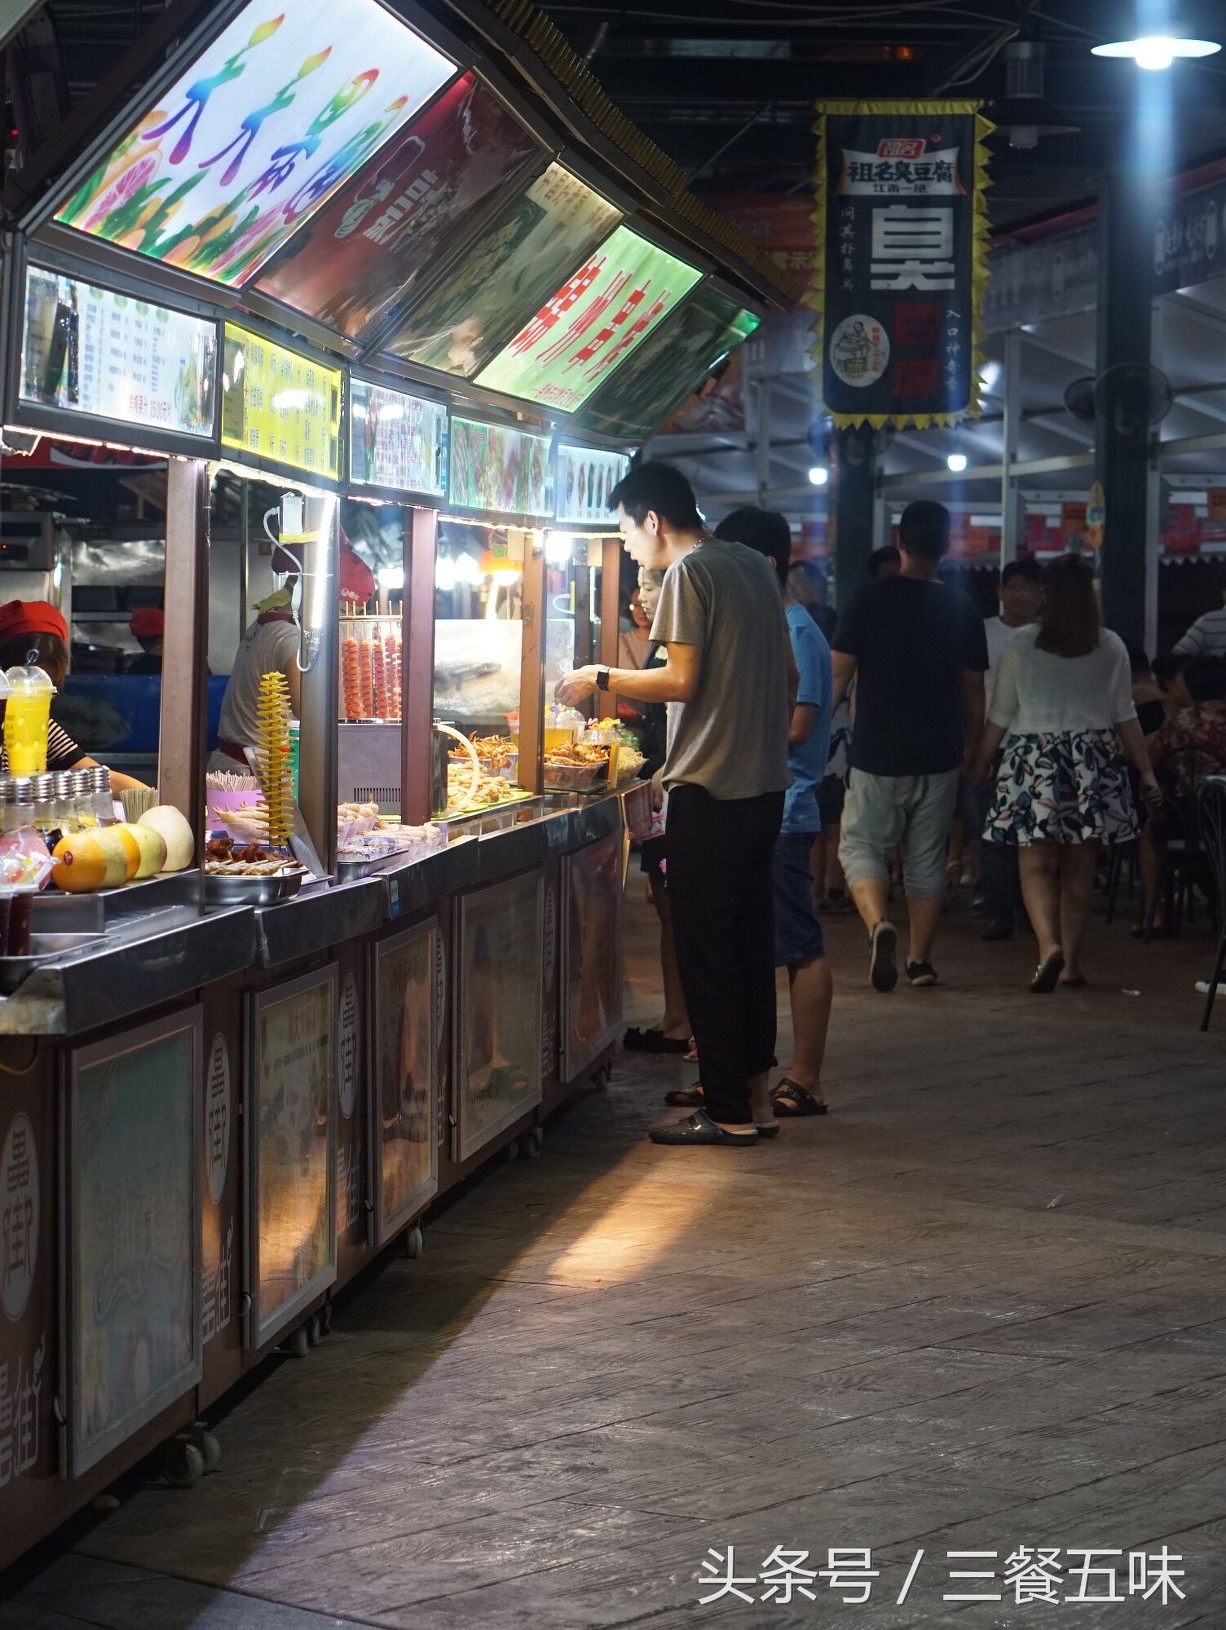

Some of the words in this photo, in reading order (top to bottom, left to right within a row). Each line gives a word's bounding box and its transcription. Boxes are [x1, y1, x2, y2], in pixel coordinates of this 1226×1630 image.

[848, 160, 954, 184] 祖名臭豆腐
